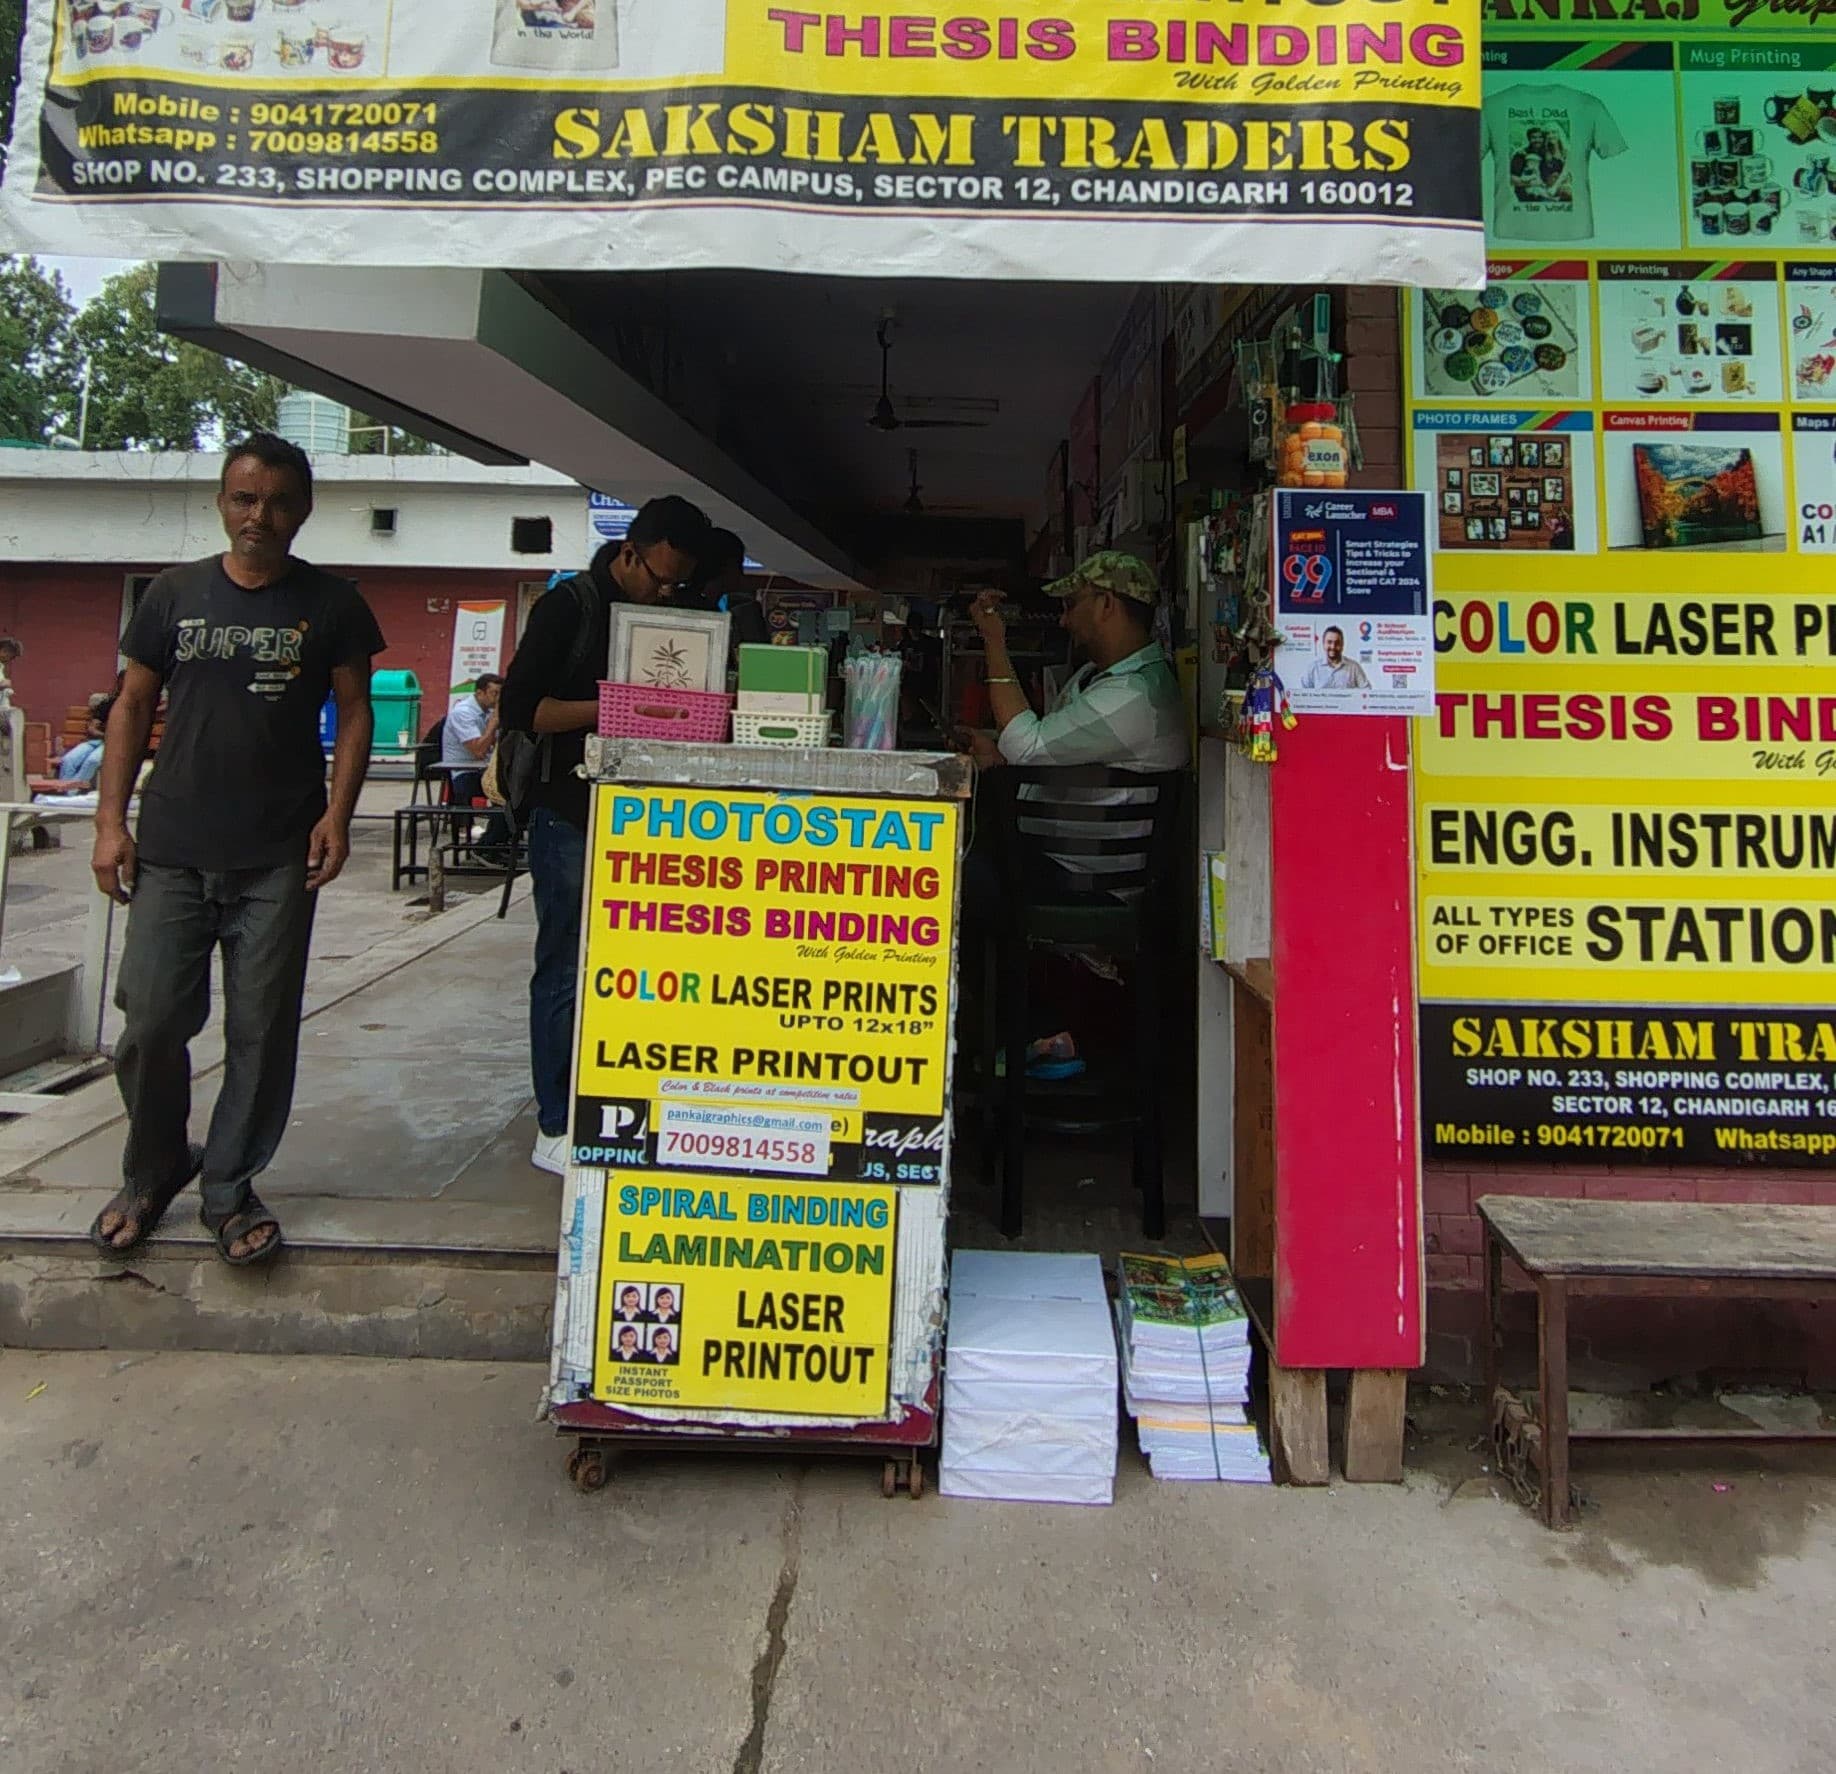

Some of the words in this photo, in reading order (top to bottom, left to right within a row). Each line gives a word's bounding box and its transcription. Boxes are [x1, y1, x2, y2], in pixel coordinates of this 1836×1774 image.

[767, 8, 1076, 61] THESIS
[1107, 19, 1464, 67] BINDING
[1690, 49, 1725, 67] Mug
[1731, 48, 1801, 67] Printing
[1173, 71, 1238, 92] With
[1250, 70, 1341, 96] Golden
[1354, 71, 1464, 97] Printing
[113, 92, 218, 121] Mobile
[250, 102, 438, 126] 9041720071
[1542, 107, 1569, 118] Dad
[77, 125, 216, 153] Whatsapp
[249, 130, 439, 153] 7009814558
[551, 102, 976, 165] SAKSHAM
[1002, 115, 1412, 172] TRADERS
[72, 160, 141, 184] SHOP
[150, 160, 206, 185] NO.
[217, 165, 287, 191] 233,
[295, 167, 463, 193] SHOPPING
[472, 168, 636, 196] COMPLEX,
[645, 166, 706, 191] PEC
[717, 165, 863, 202] CAMPUS,
[874, 174, 1002, 200] SECTOR
[1014, 177, 1060, 206] 12,
[1071, 179, 1288, 205] CHANDIGARH
[1301, 181, 1413, 206] 160012
[1610, 264, 1628, 275] UV
[1630, 263, 1670, 278] Printing
[1417, 412, 1461, 426] PHOTO
[1464, 412, 1517, 426] FRAMES
[1610, 414, 1647, 427] Canvas
[1650, 413, 1688, 429] Printing
[1796, 416, 1829, 429] Maps
[1325, 501, 1354, 511] Career
[1325, 510, 1366, 519] Launcher
[1372, 506, 1393, 516] MBA
[1802, 503, 1836, 519] CO
[1345, 540, 1372, 548] Smart
[1373, 540, 1419, 549] Strategies
[1803, 524, 1825, 543] A1
[1283, 554, 1333, 598] 99
[1433, 599, 1598, 655] COLOR
[1614, 601, 1778, 656] LASER
[1795, 603, 1836, 656] P
[175, 626, 303, 661] SUPER
[1435, 693, 1673, 742] THESIS
[1752, 749, 1806, 769] With
[611, 795, 945, 851] PHOTOSTAT
[1431, 810, 1592, 867] ENGG.
[1612, 811, 1836, 869] INSTRUM
[606, 850, 743, 890] THESIS
[755, 858, 940, 900] PRINTING
[602, 900, 751, 937] THESIS
[764, 908, 940, 947] BINDING
[1432, 906, 1481, 926] ALL
[1489, 907, 1574, 927] TYPES
[796, 945, 829, 960] With
[833, 946, 878, 964] Golden
[882, 948, 937, 966] Printing
[1436, 934, 1470, 954] OF
[1478, 935, 1572, 955] OFFICE
[594, 966, 701, 1005] COLOR
[711, 974, 812, 1010] LASER
[822, 979, 938, 1016] PRINTS
[779, 1014, 844, 1032] UPTO
[1452, 1018, 1717, 1061] SAKSHAM
[1730, 1021, 1836, 1062] TRA
[596, 1039, 718, 1074] LASER
[732, 1048, 928, 1086] PRINTOUT
[661, 1079, 687, 1092] Color
[703, 1081, 731, 1093] Black
[733, 1084, 763, 1097] prints
[1466, 1068, 1521, 1087] SHOP
[1527, 1069, 1563, 1087] NO.
[1568, 1070, 1610, 1091] 233,
[1615, 1071, 1719, 1090] SHOPPING
[1725, 1072, 1829, 1094] COMPLEX,
[667, 1107, 823, 1132] pankajgraphics@gmail.com
[1552, 1096, 1633, 1115] SECTOR
[1639, 1096, 1669, 1118] 12,
[1673, 1098, 1809, 1117] CHANDIGARH
[665, 1132, 815, 1164] 7009814558
[1435, 1123, 1515, 1145] Mobile
[1537, 1125, 1685, 1148] 9041720071
[1714, 1128, 1836, 1155] Whatsapp
[618, 1185, 737, 1222] SPIRAL
[748, 1193, 888, 1229] BINDING
[618, 1231, 885, 1276] LAMINATION
[737, 1290, 845, 1334] LASER
[619, 1366, 668, 1378] INSTANT
[702, 1339, 874, 1384] PRINTOUT
[605, 1385, 632, 1397] SIZE
[634, 1387, 681, 1400] PHOTOS
[613, 1375, 672, 1388] PASSPORT
